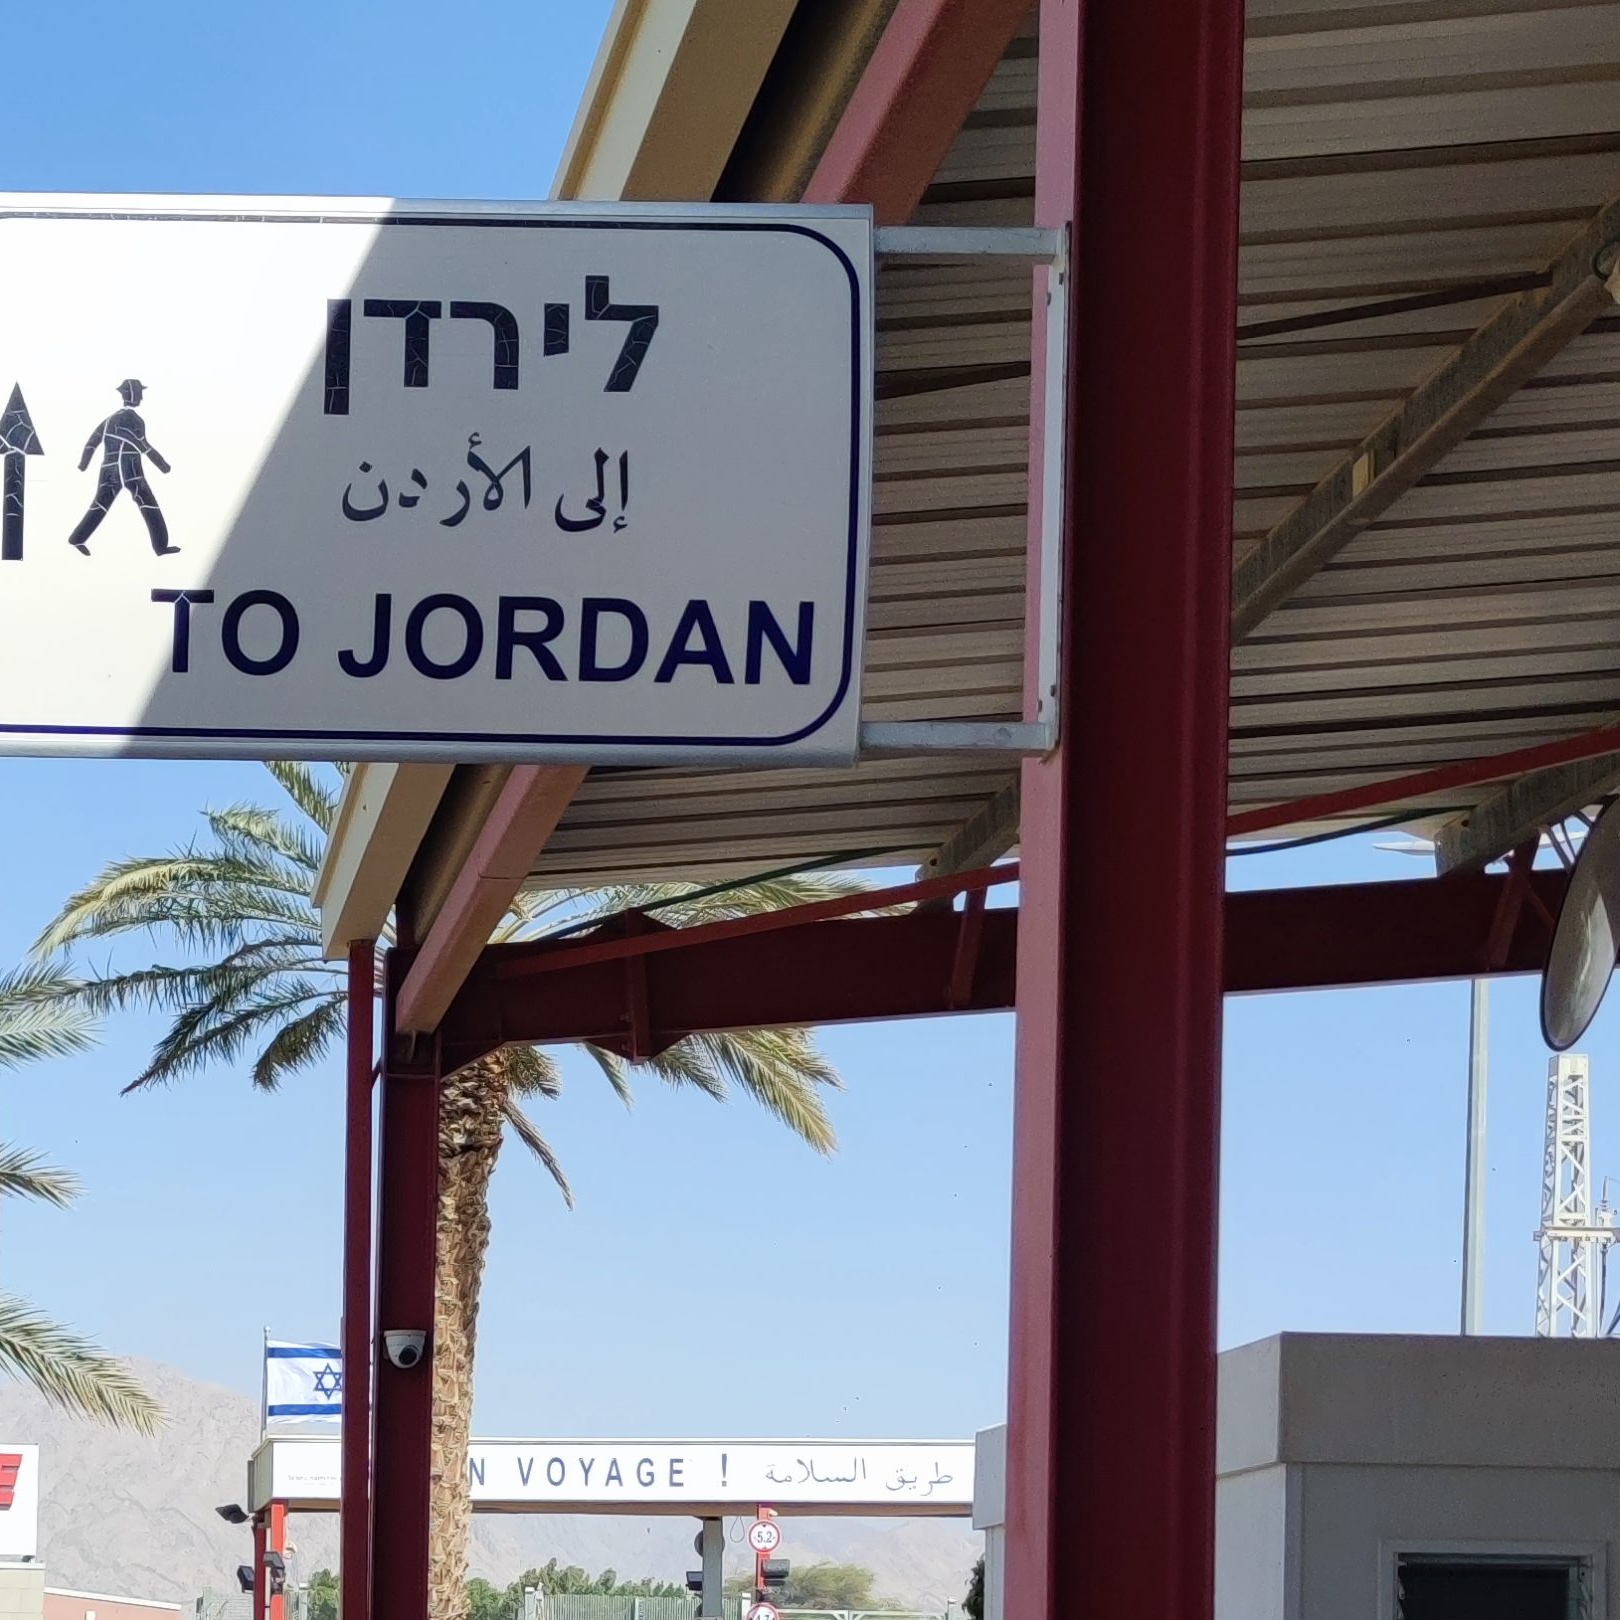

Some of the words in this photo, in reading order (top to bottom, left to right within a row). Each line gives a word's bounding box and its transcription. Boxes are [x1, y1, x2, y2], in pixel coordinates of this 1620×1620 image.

[323, 275, 660, 416] לירדן
[341, 431, 532, 530] الأردن
[554, 447, 630, 534] إلى
[150, 587, 301, 676] TO
[337, 592, 814, 686] JORDAN
[517, 1456, 684, 1487] VOYAGE
[765, 1455, 867, 1485] السلامة
[885, 1461, 954, 1497] طريق
[756, 1530, 773, 1544] 5.2
